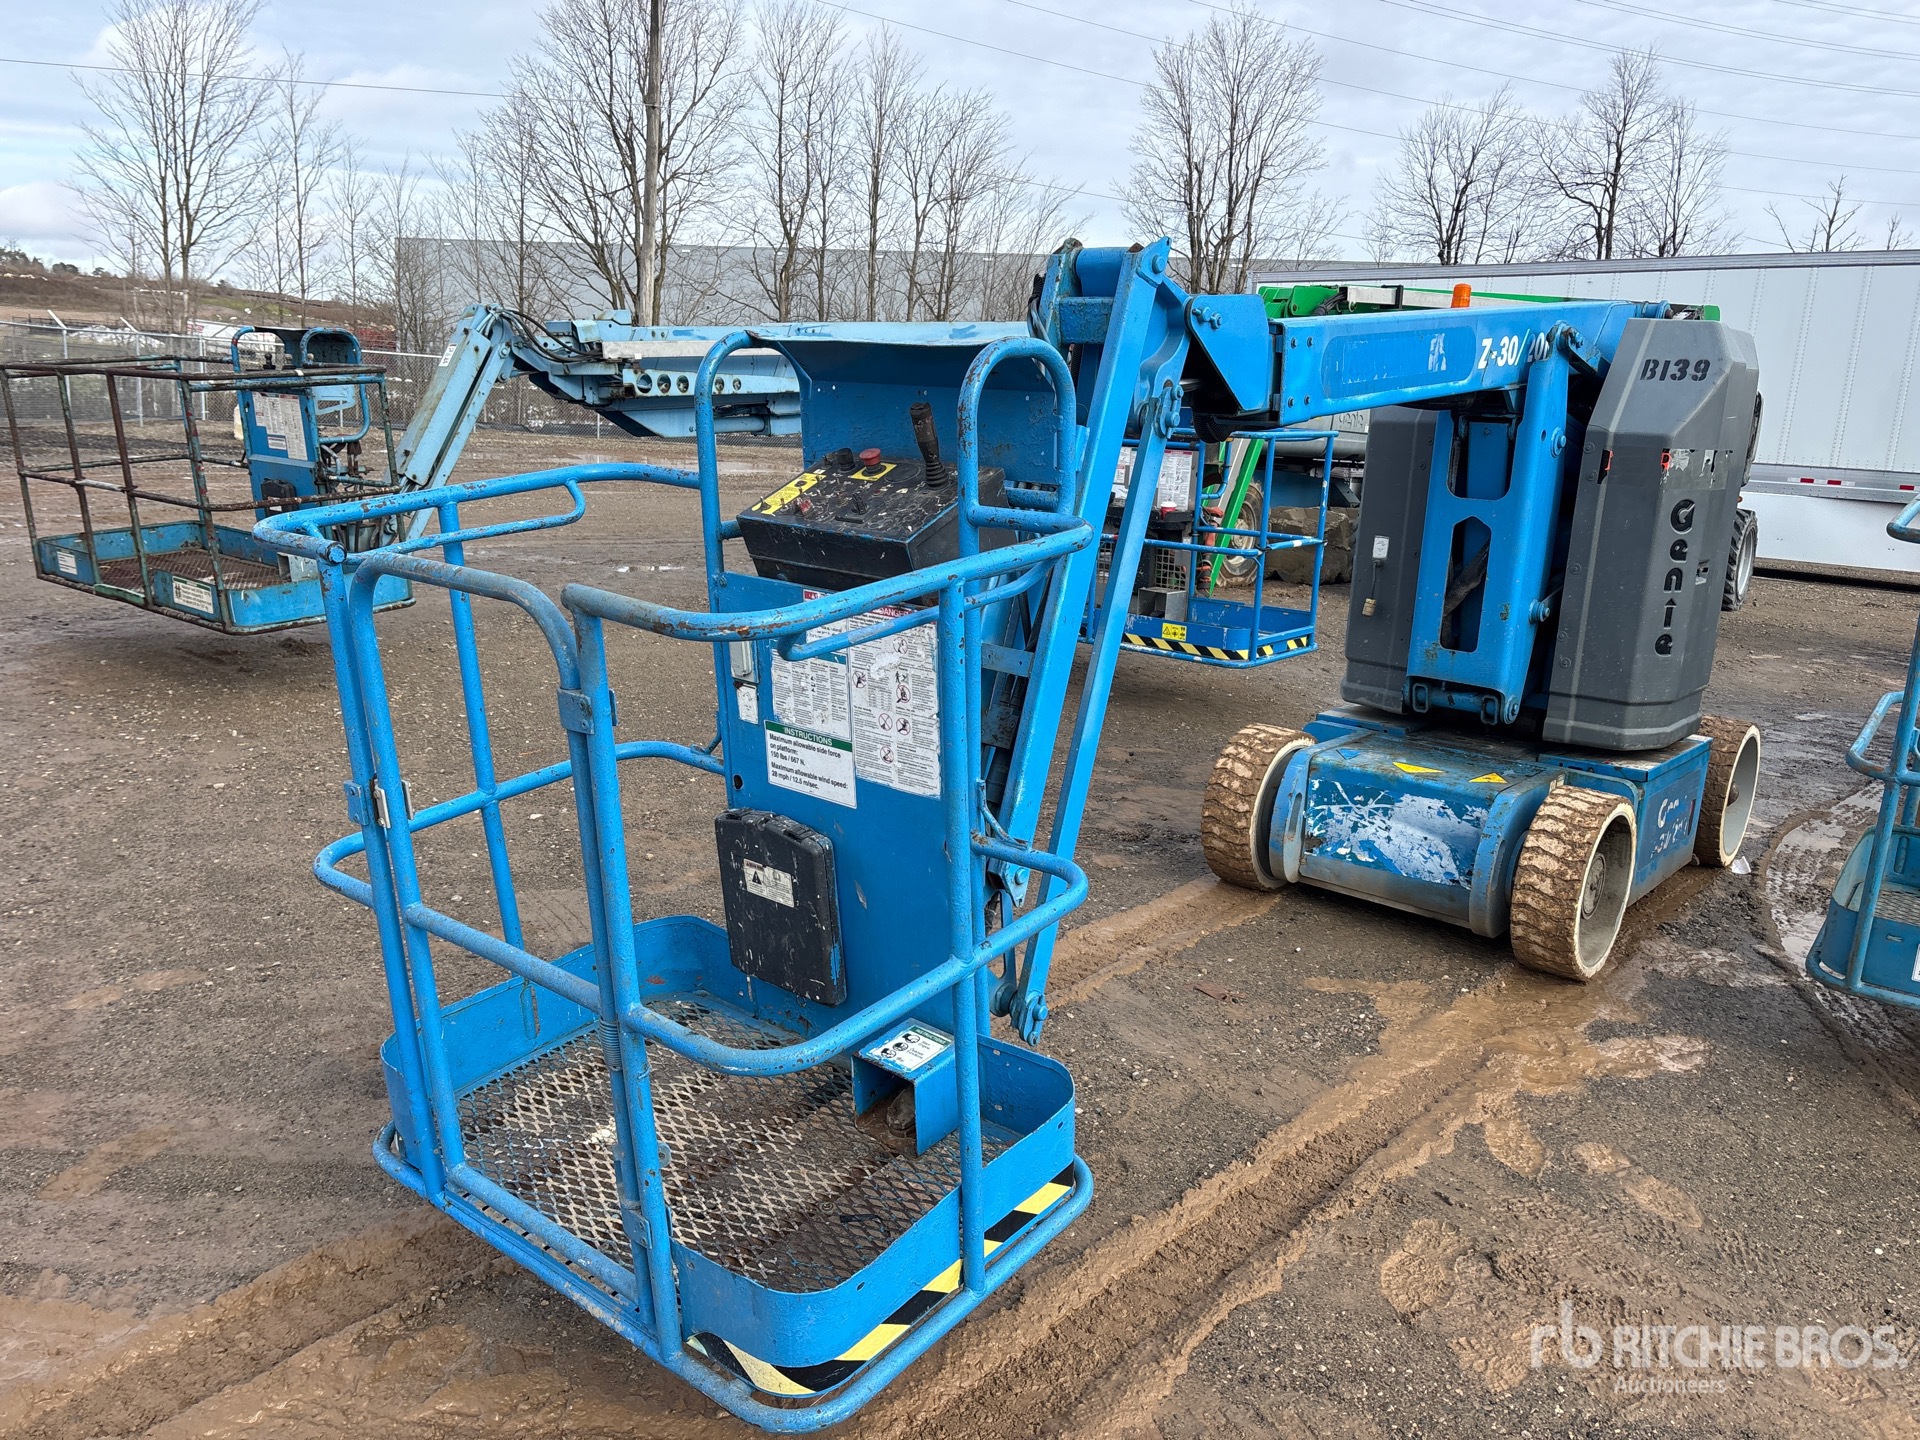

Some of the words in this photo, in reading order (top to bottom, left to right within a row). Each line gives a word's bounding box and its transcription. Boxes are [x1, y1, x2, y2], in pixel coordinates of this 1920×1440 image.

[1639, 359, 1711, 381] B139
[1654, 499, 1696, 657] Genie
[769, 733, 792, 745] Maximum
[793, 740, 816, 752] allowable
[816, 747, 828, 755] side
[828, 748, 841, 759] force
[784, 727, 833, 746] INSTRUCTIONS
[771, 750, 779, 759] 150
[777, 743, 798, 755] platform:
[771, 761, 794, 774] Maximum
[795, 769, 818, 781] allowable
[818, 776, 830, 785] wind
[831, 779, 848, 789] speed:
[779, 773, 789, 781] mph
[792, 776, 803, 785] 12.5
